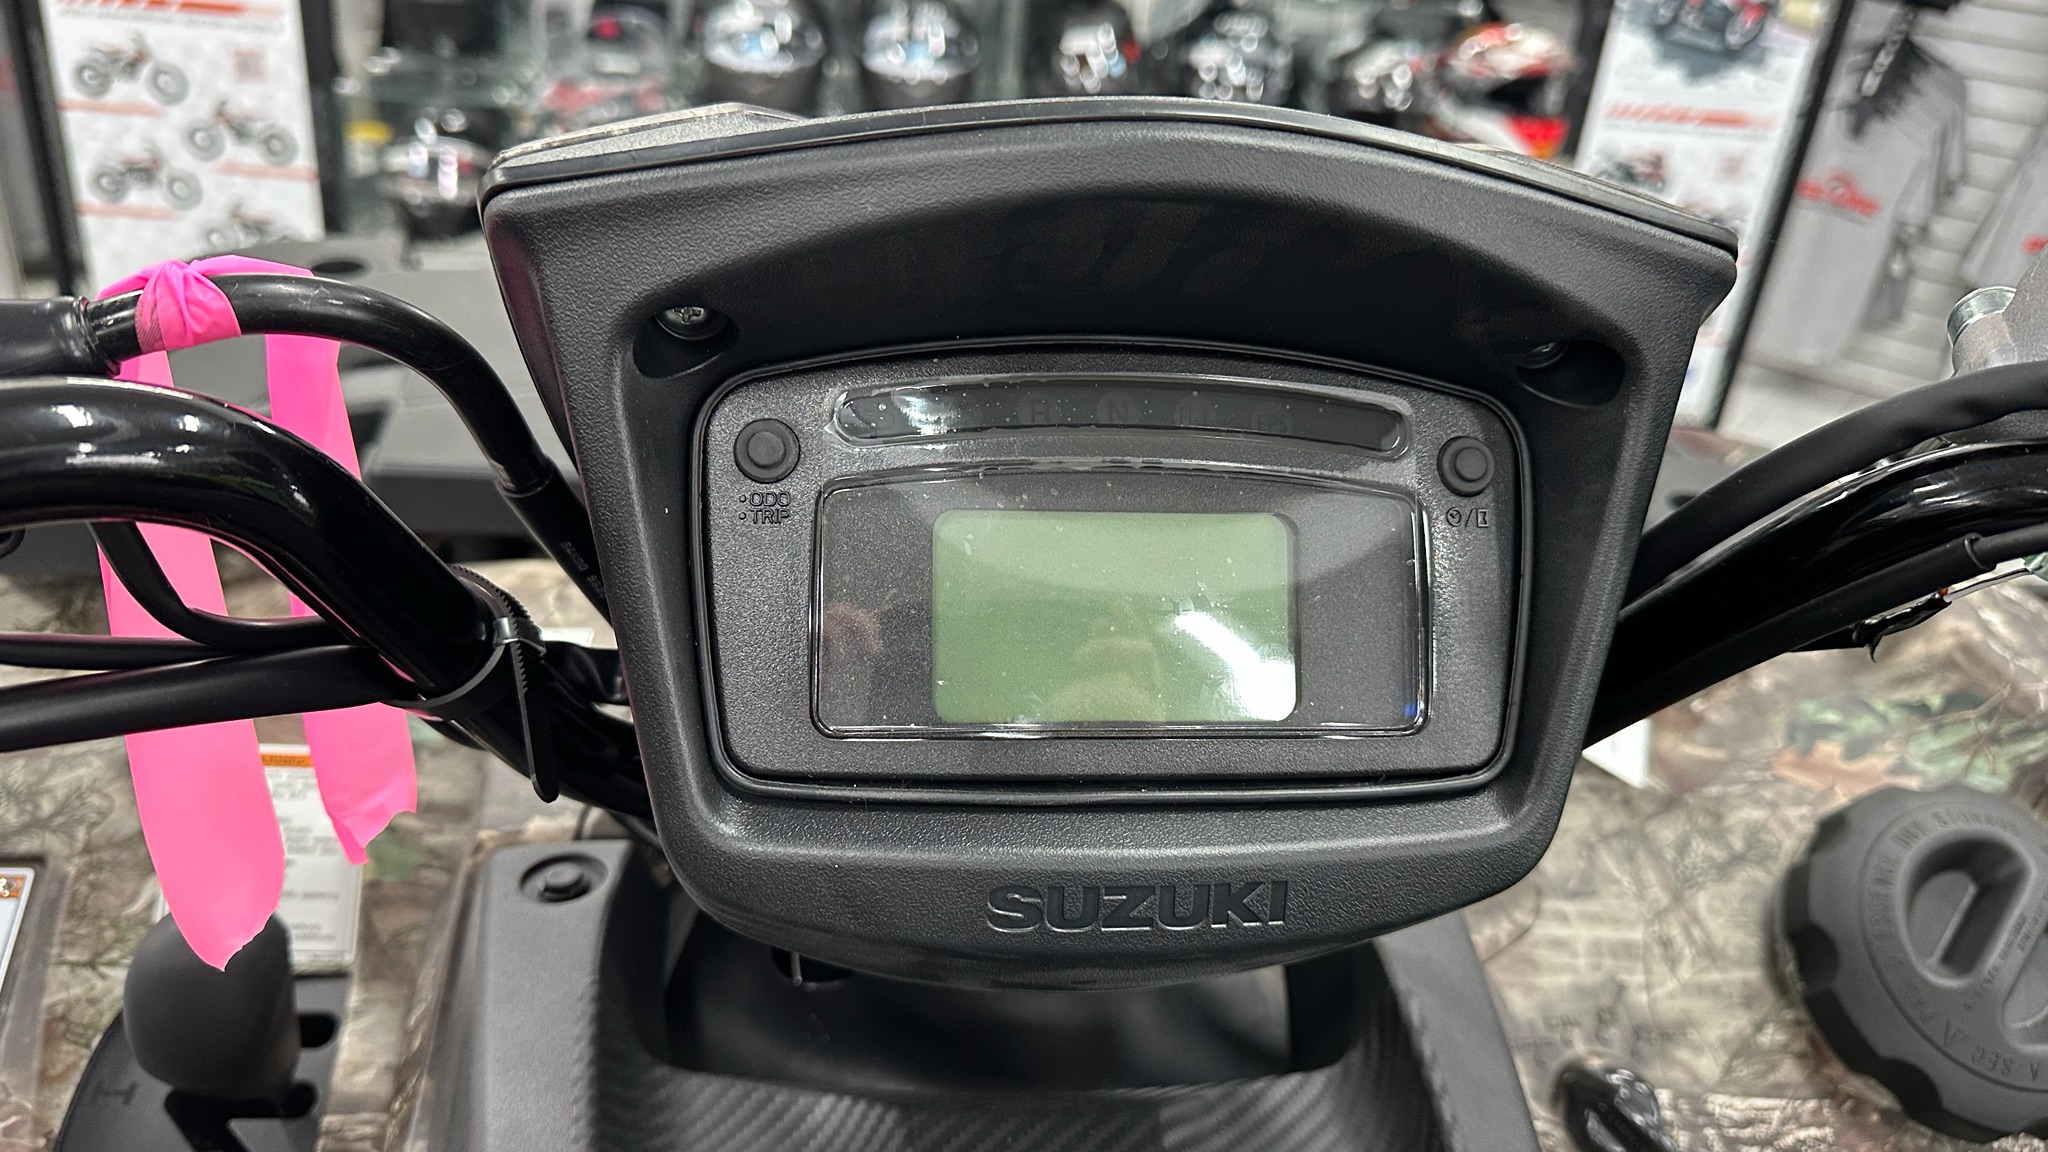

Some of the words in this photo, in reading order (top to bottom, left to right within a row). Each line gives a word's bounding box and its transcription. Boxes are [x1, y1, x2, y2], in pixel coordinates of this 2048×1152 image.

[1030, 399, 1051, 423] R
[1108, 400, 1129, 423] N
[750, 491, 791, 507] ODO
[749, 507, 791, 525] TRIP
[985, 880, 1289, 933] SUZUKI
